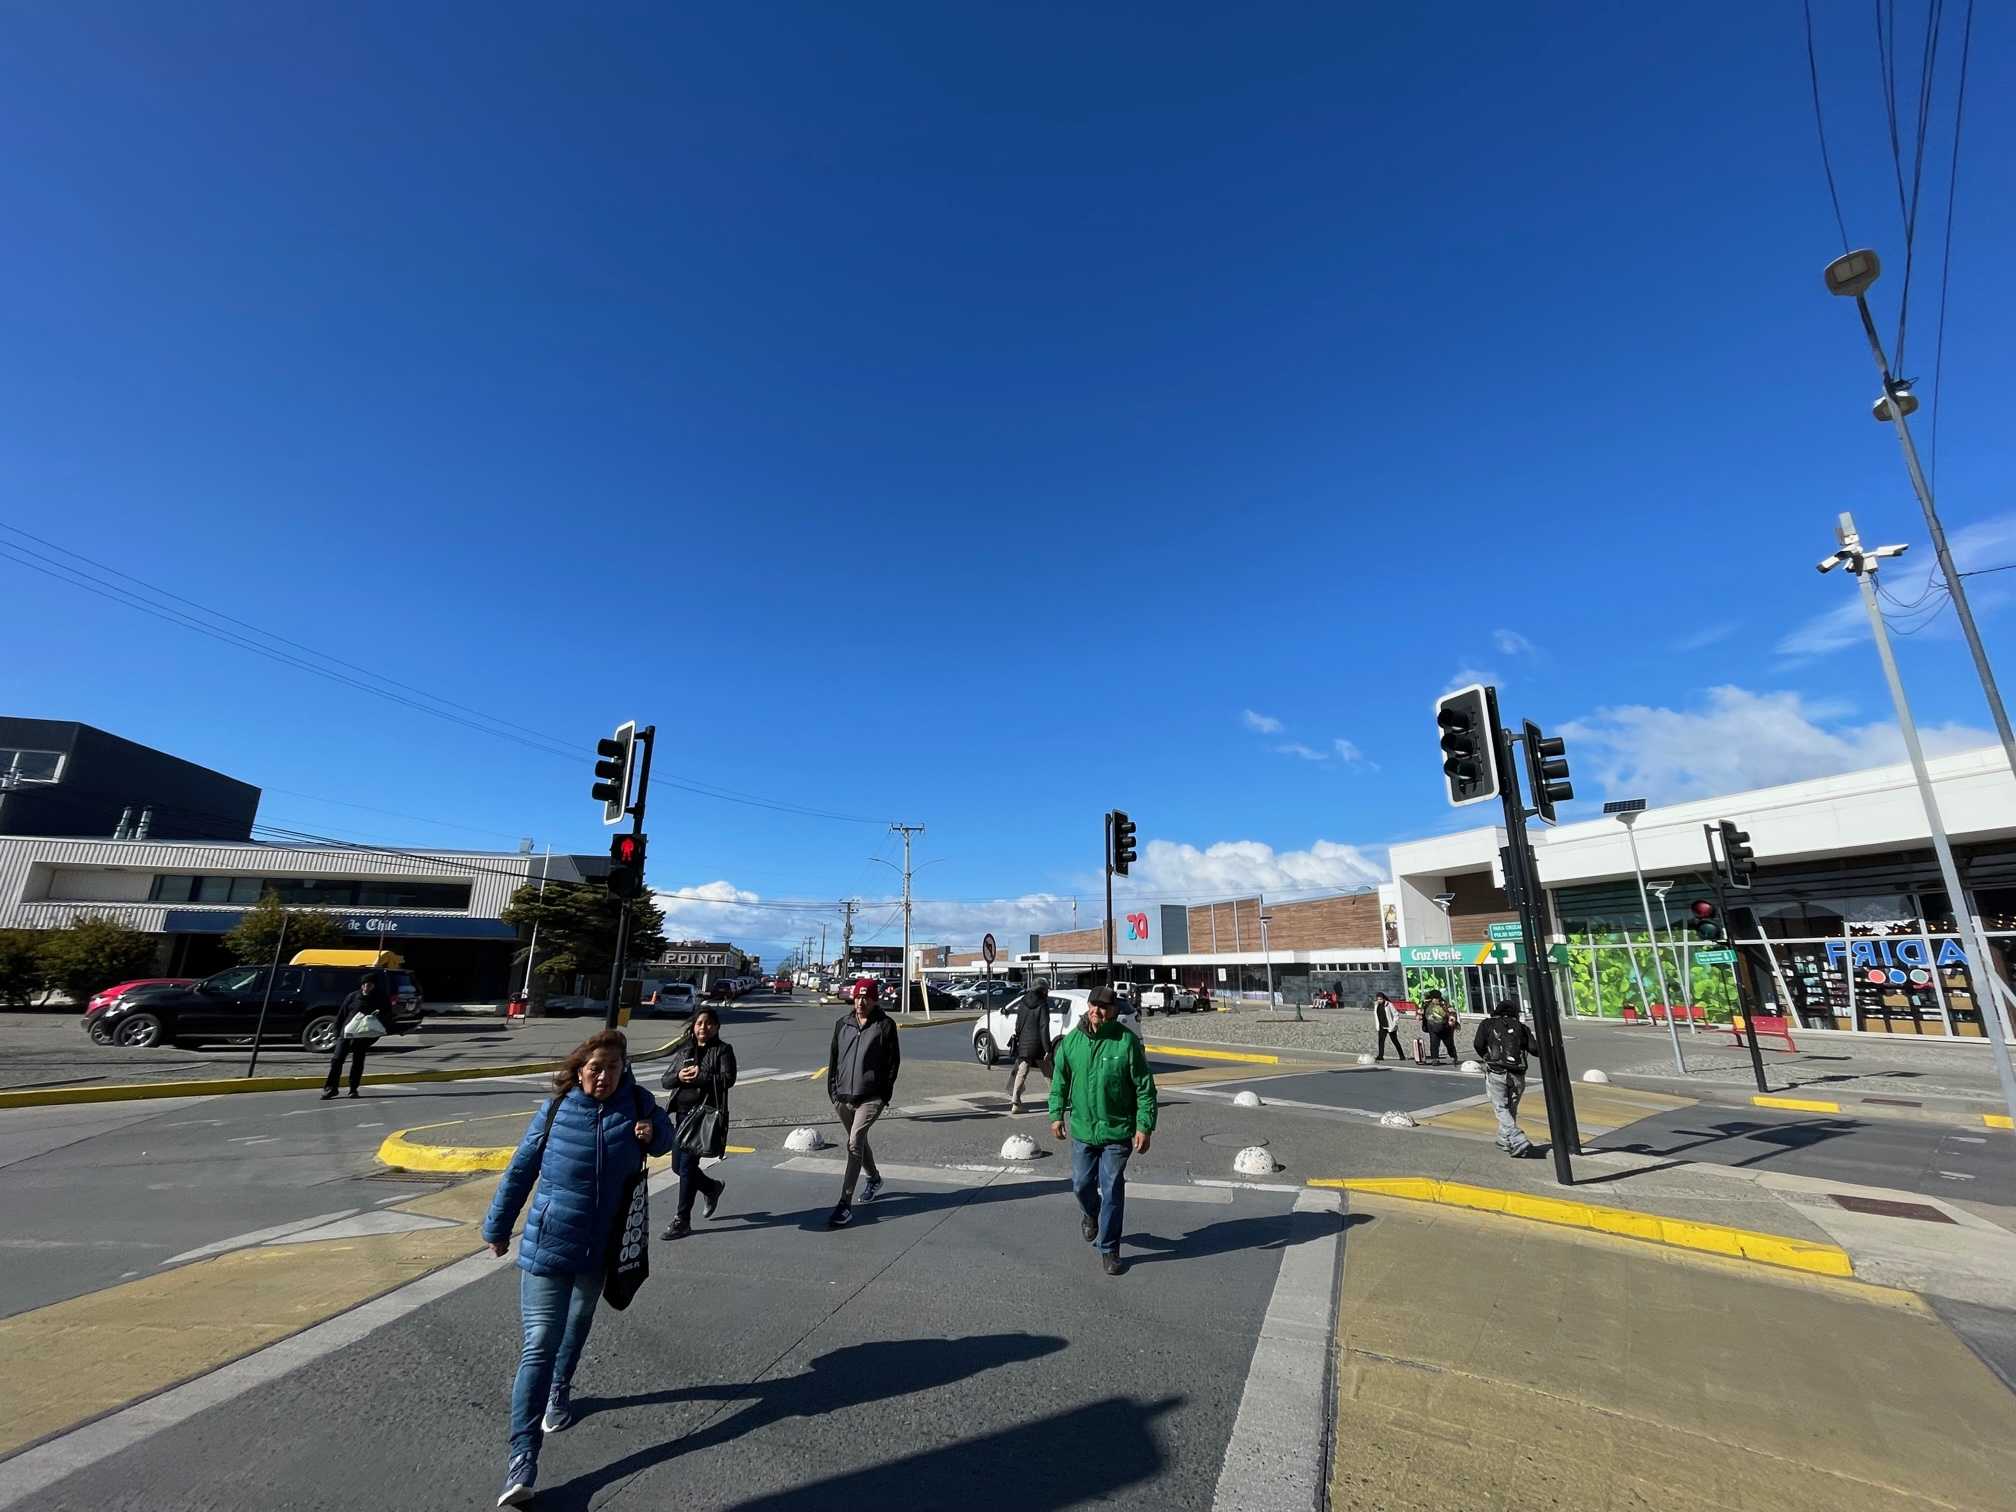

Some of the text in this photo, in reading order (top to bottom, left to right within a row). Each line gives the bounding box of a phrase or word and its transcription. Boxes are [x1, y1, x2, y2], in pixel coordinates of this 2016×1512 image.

[347, 919, 361, 930] de
[365, 918, 398, 931] Chile
[664, 953, 722, 964] POINT
[1411, 949, 1431, 961] Cruz
